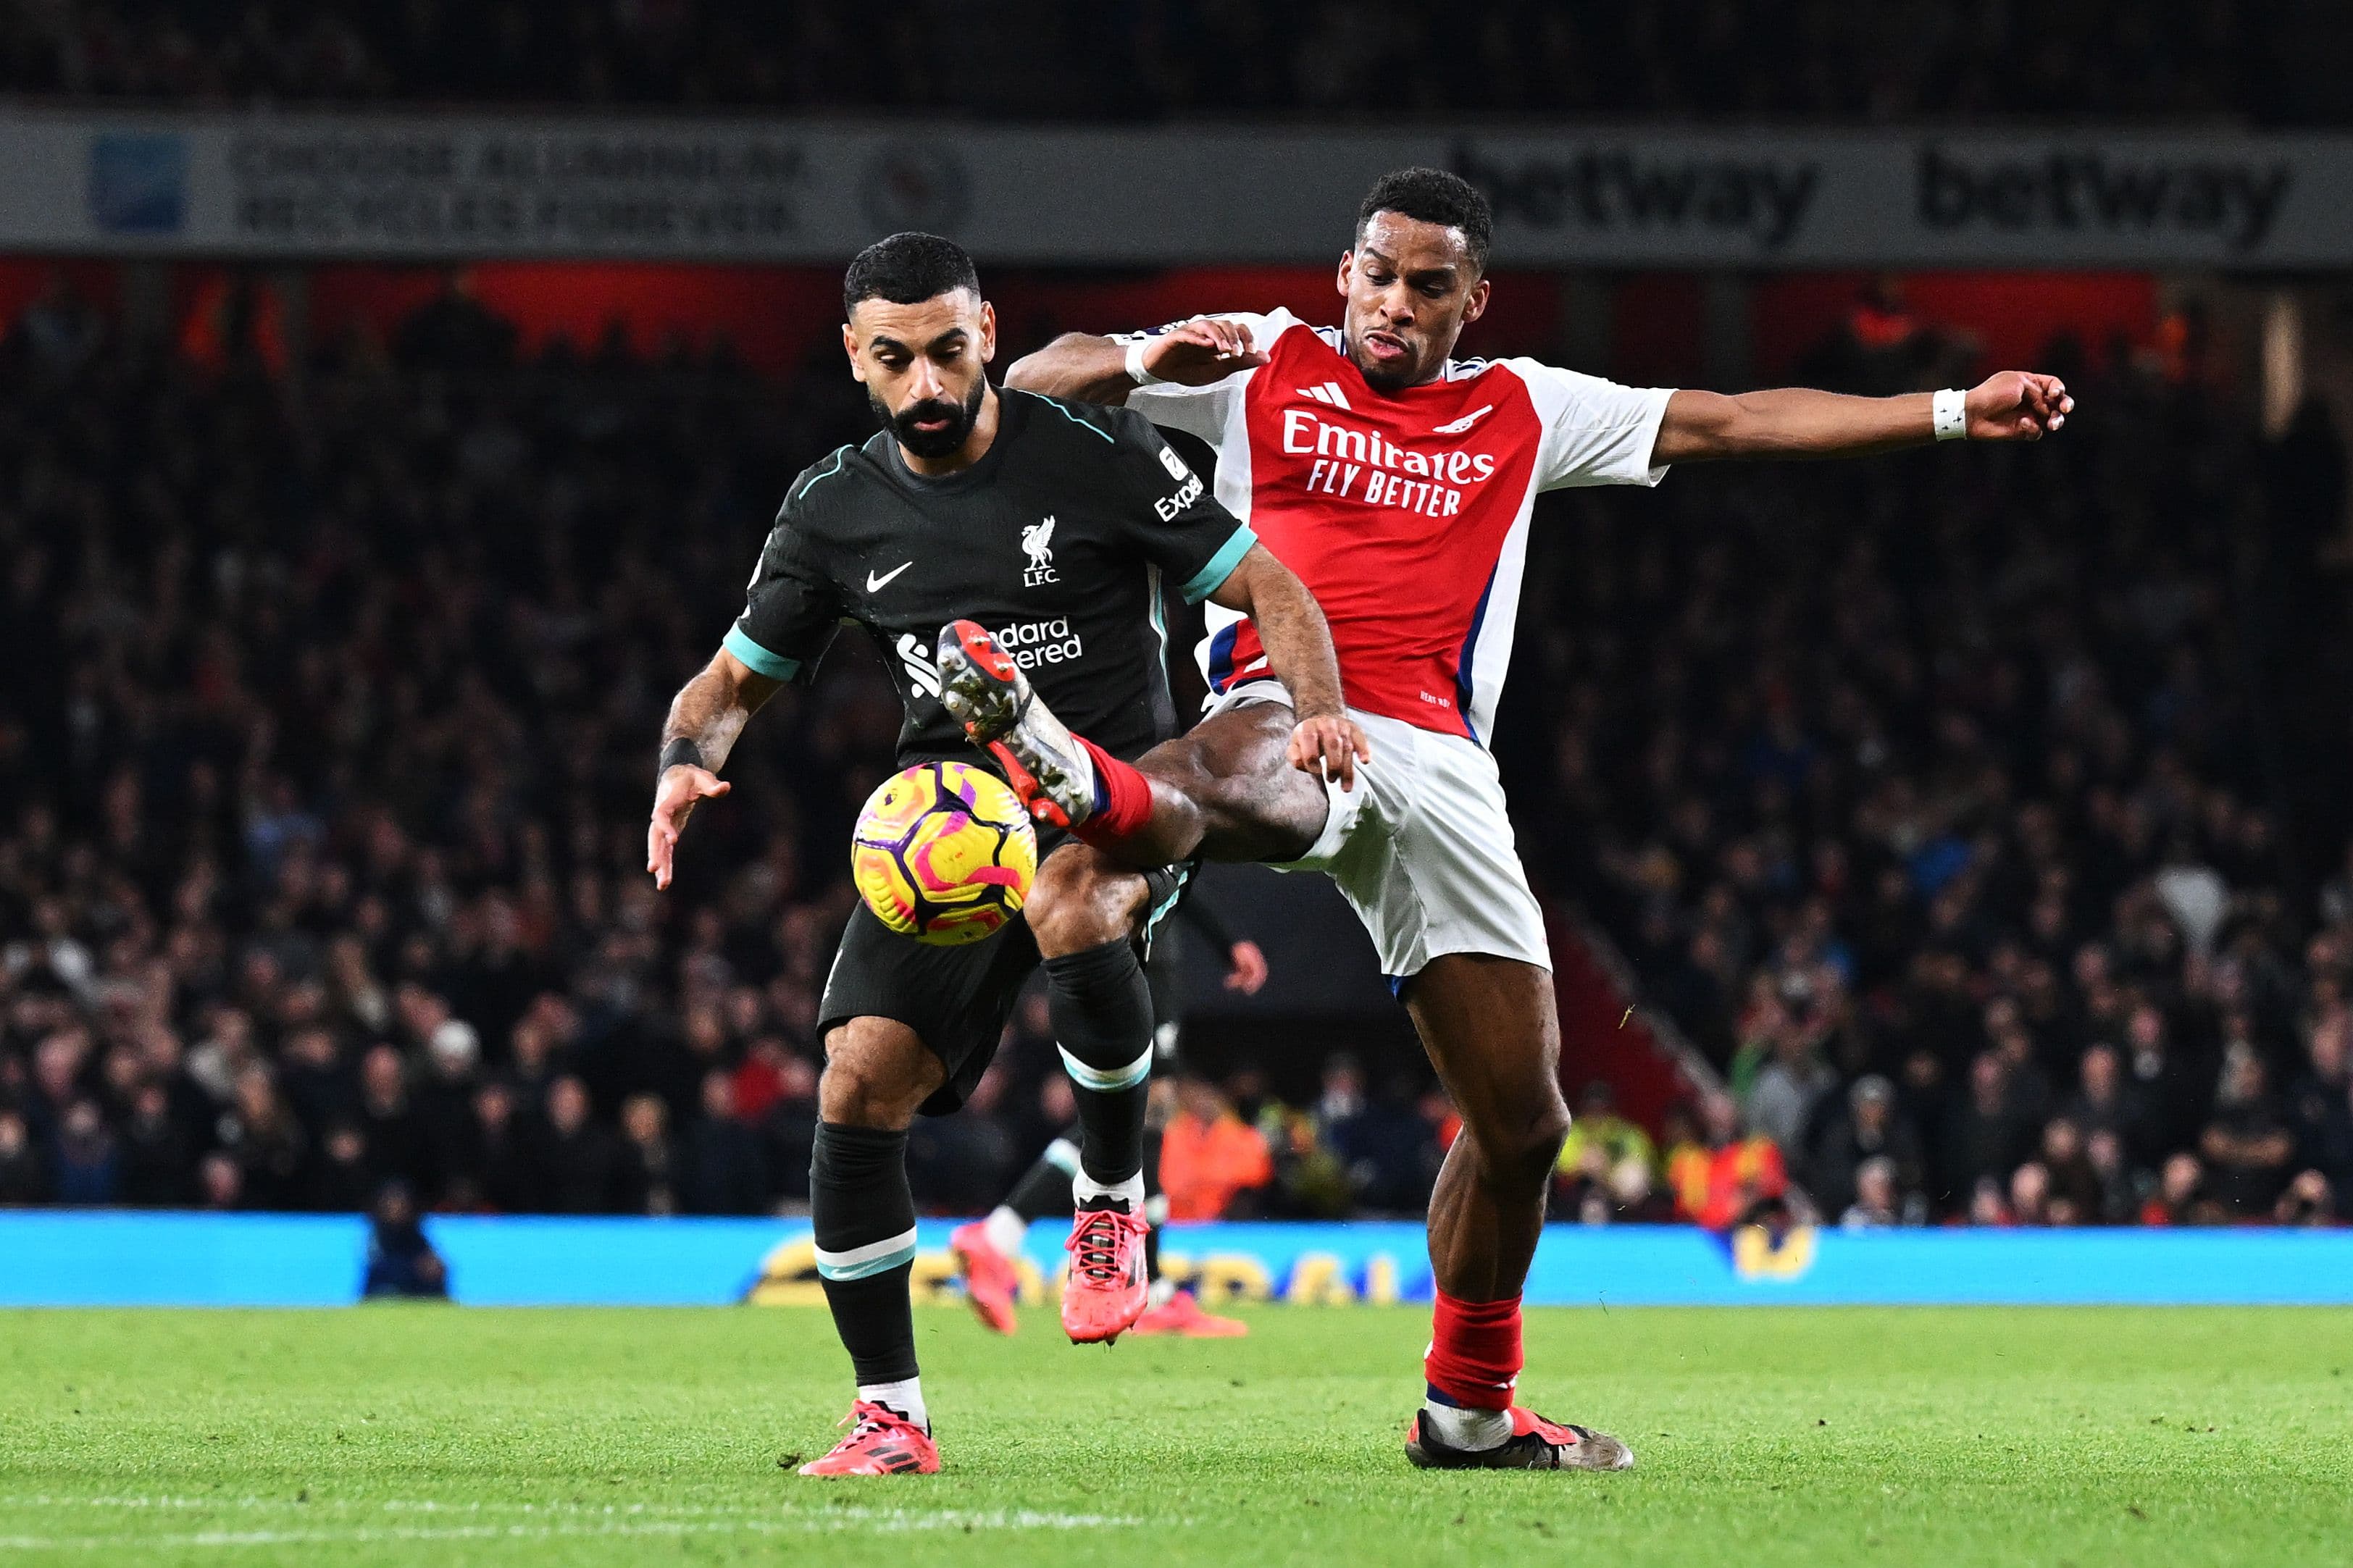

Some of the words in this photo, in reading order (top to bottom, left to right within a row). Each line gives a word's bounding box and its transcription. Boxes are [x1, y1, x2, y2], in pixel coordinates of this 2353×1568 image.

[1918, 141, 2291, 251] betway
[1283, 409, 1495, 485] Emirates
[1306, 459, 1361, 497] FLY
[1364, 470, 1460, 517] BETTER
